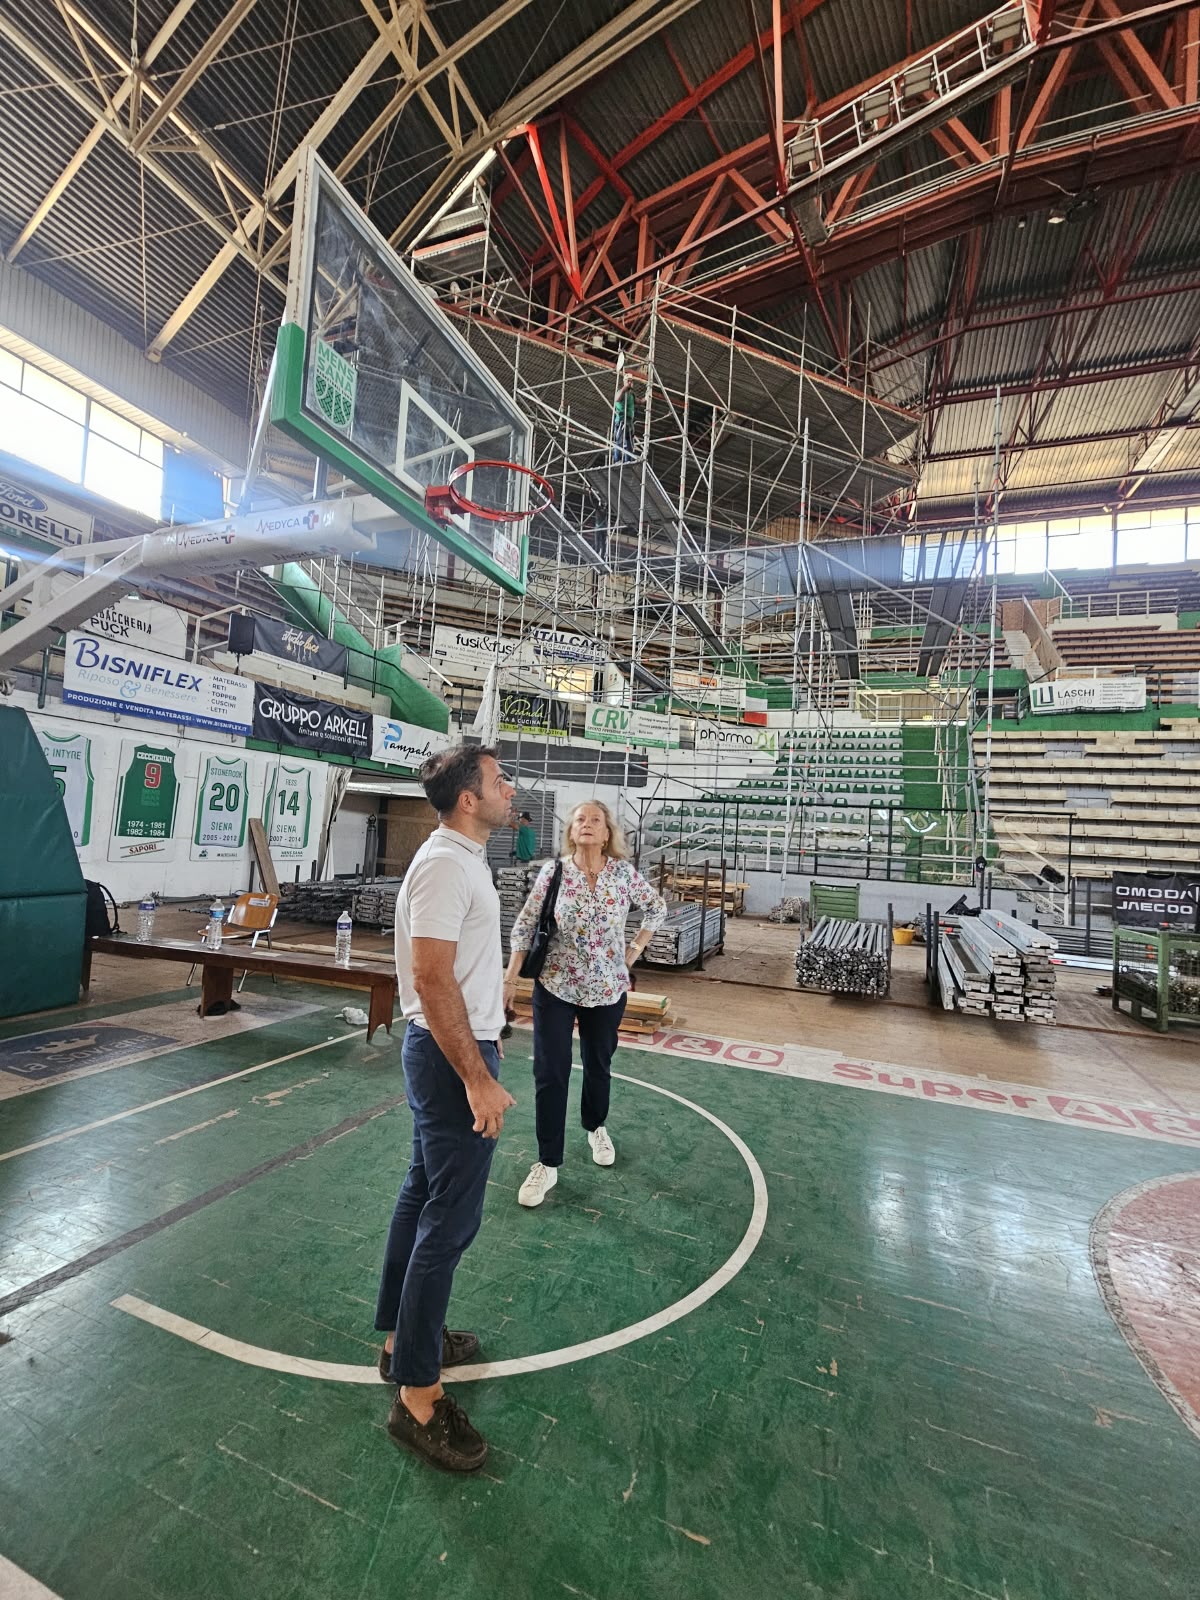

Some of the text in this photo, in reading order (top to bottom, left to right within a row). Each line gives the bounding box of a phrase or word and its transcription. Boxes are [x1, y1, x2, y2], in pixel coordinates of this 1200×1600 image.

[318, 340, 355, 383] MENS
[317, 356, 352, 397] SANA
[0, 482, 36, 508] Ford
[0, 503, 82, 545] ORELLI
[256, 517, 300, 535] MEDYCA
[90, 618, 129, 638] PUCK
[95, 610, 152, 634] BACCHERIA
[73, 638, 203, 693] BISNIFLEX
[78, 669, 197, 703] Riposo & Benessere
[212, 683, 227, 691] RETI
[213, 676, 248, 689] MATERASSI
[212, 691, 237, 701] TOPPER
[1057, 689, 1095, 698] LASCHI
[210, 706, 228, 715] LETTI
[211, 699, 236, 709] CUSCINI
[67, 693, 117, 708] PRODUZIONE
[125, 704, 154, 715] VENDITA
[155, 710, 192, 721] MATERASSI
[196, 717, 247, 732] WWW.BISNIFLEX.IT
[259, 698, 368, 740] GRUPPO ARKELL
[324, 733, 347, 743] soluzioni
[384, 723, 435, 760] Pampalo
[701, 728, 753, 744] pharma
[52, 748, 82, 760] INTYRE
[144, 762, 161, 789] 9
[210, 768, 243, 779] STONEROOK
[209, 782, 240, 812] 20
[278, 789, 300, 816] 14
[126, 828, 143, 836] 1982
[127, 820, 144, 828] 1974
[150, 821, 166, 829] 1981
[211, 821, 233, 831] SIENA
[276, 825, 297, 833] SIENA
[129, 843, 157, 854] SAPORI
[1116, 886, 1193, 899] OMODA
[1116, 901, 1193, 914] JAECOO
[832, 1062, 1200, 1140] Super A&
